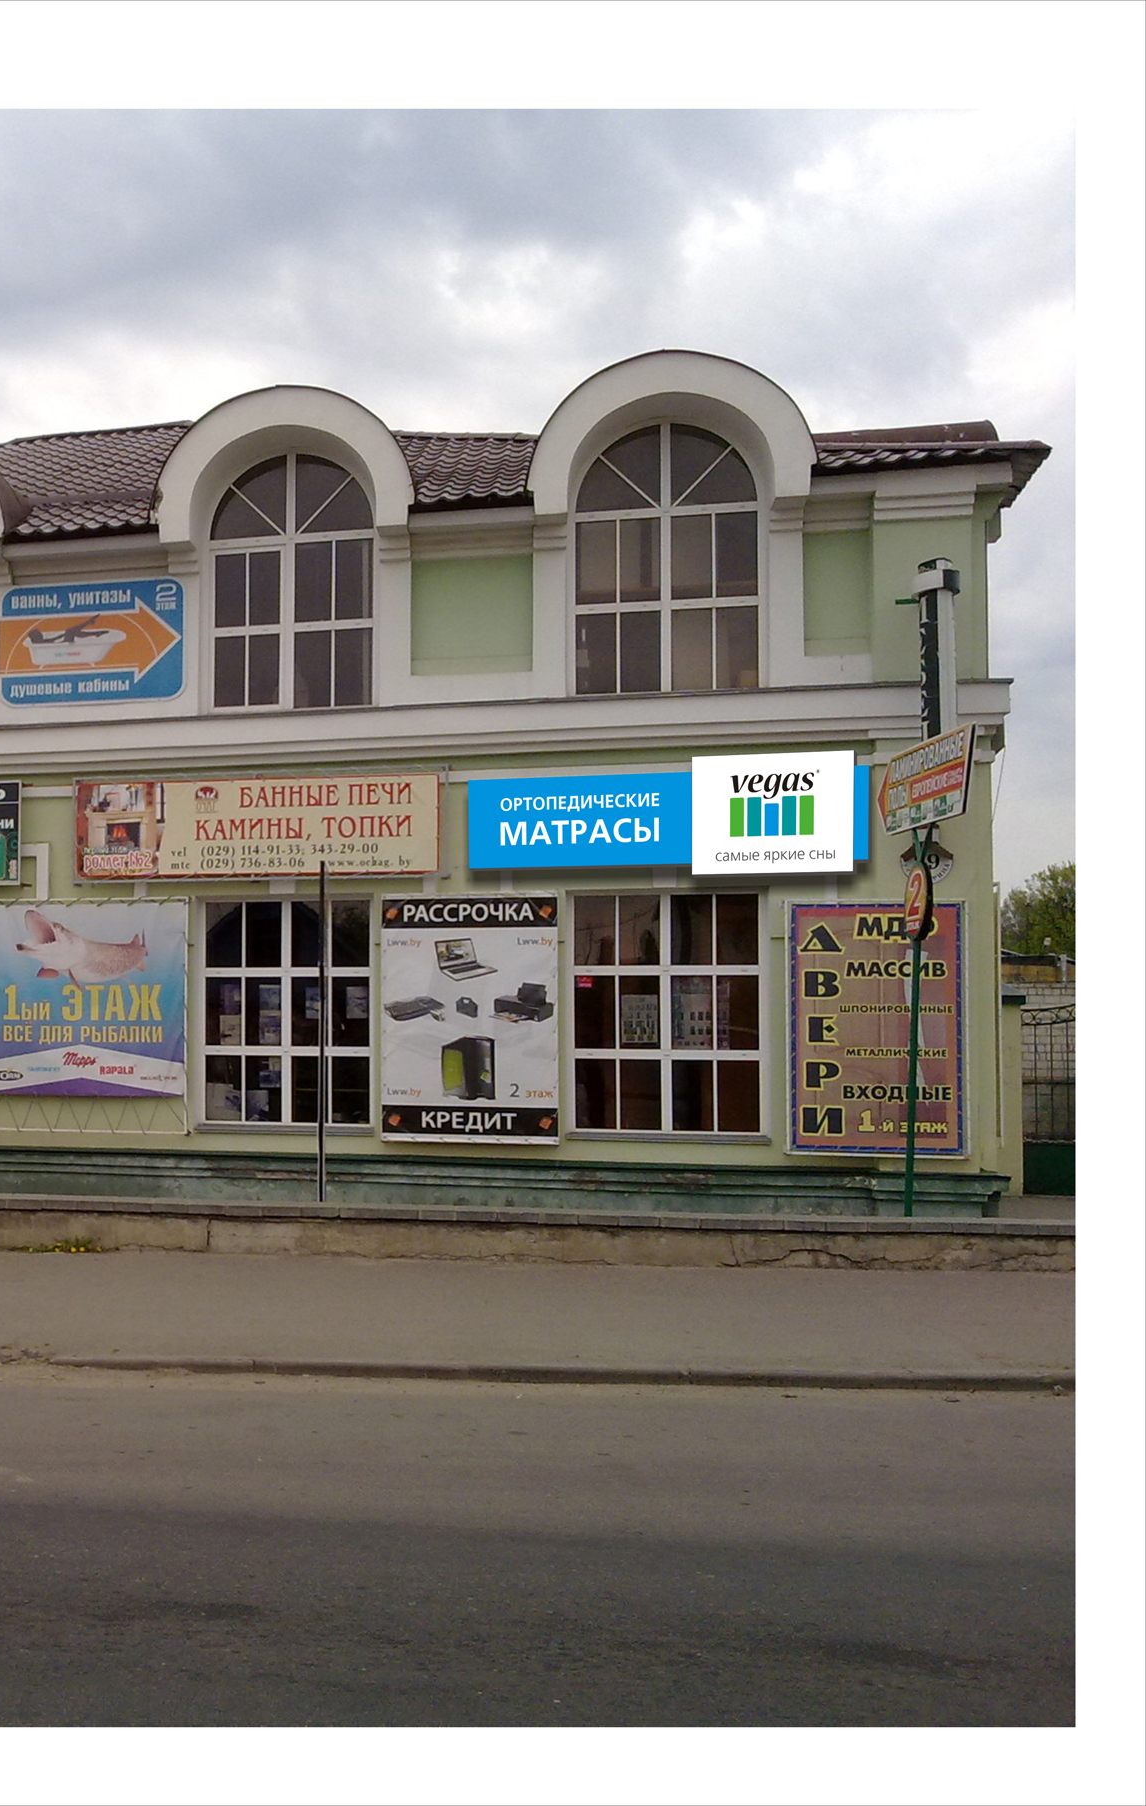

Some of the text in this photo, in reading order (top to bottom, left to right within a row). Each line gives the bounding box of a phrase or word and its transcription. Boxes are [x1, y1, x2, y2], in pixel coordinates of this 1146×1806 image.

[11, 589, 131, 610] ванны, унитазы
[156, 583, 177, 600] 2
[10, 679, 130, 698] душевые кабины
[239, 785, 339, 809] БАННЫЕ
[347, 783, 413, 806] ПЕЧИ
[500, 793, 660, 812] ОРТОПЕДИЧЕСКИЕ
[194, 815, 413, 842] КАМИНЫ, ТОПКИ
[500, 817, 660, 846] МАТРАСЫ
[200, 845, 235, 857] (029)
[311, 843, 379, 855] 343-29-00
[715, 848, 836, 864] самые яркие сны
[200, 858, 235, 870] (029)
[240, 857, 305, 869] 736-83-06
[909, 871, 923, 918] 2
[404, 903, 534, 923] РАССРОЧКА
[855, 915, 937, 943] МД
[387, 938, 421, 948] Lww.by
[517, 937, 553, 947] Lww.by
[3, 984, 163, 1021] 1ый ЭТАЖ
[840, 1004, 953, 1014] ШПОНИРОВННЫЕ
[39, 1026, 73, 1044] ДЛЯ
[80, 1025, 163, 1043] РЫБАЛКИ
[387, 1087, 421, 1098] Lww.by
[510, 1084, 553, 1098] 2 этаж
[421, 1111, 517, 1132] КРЕДИТ
